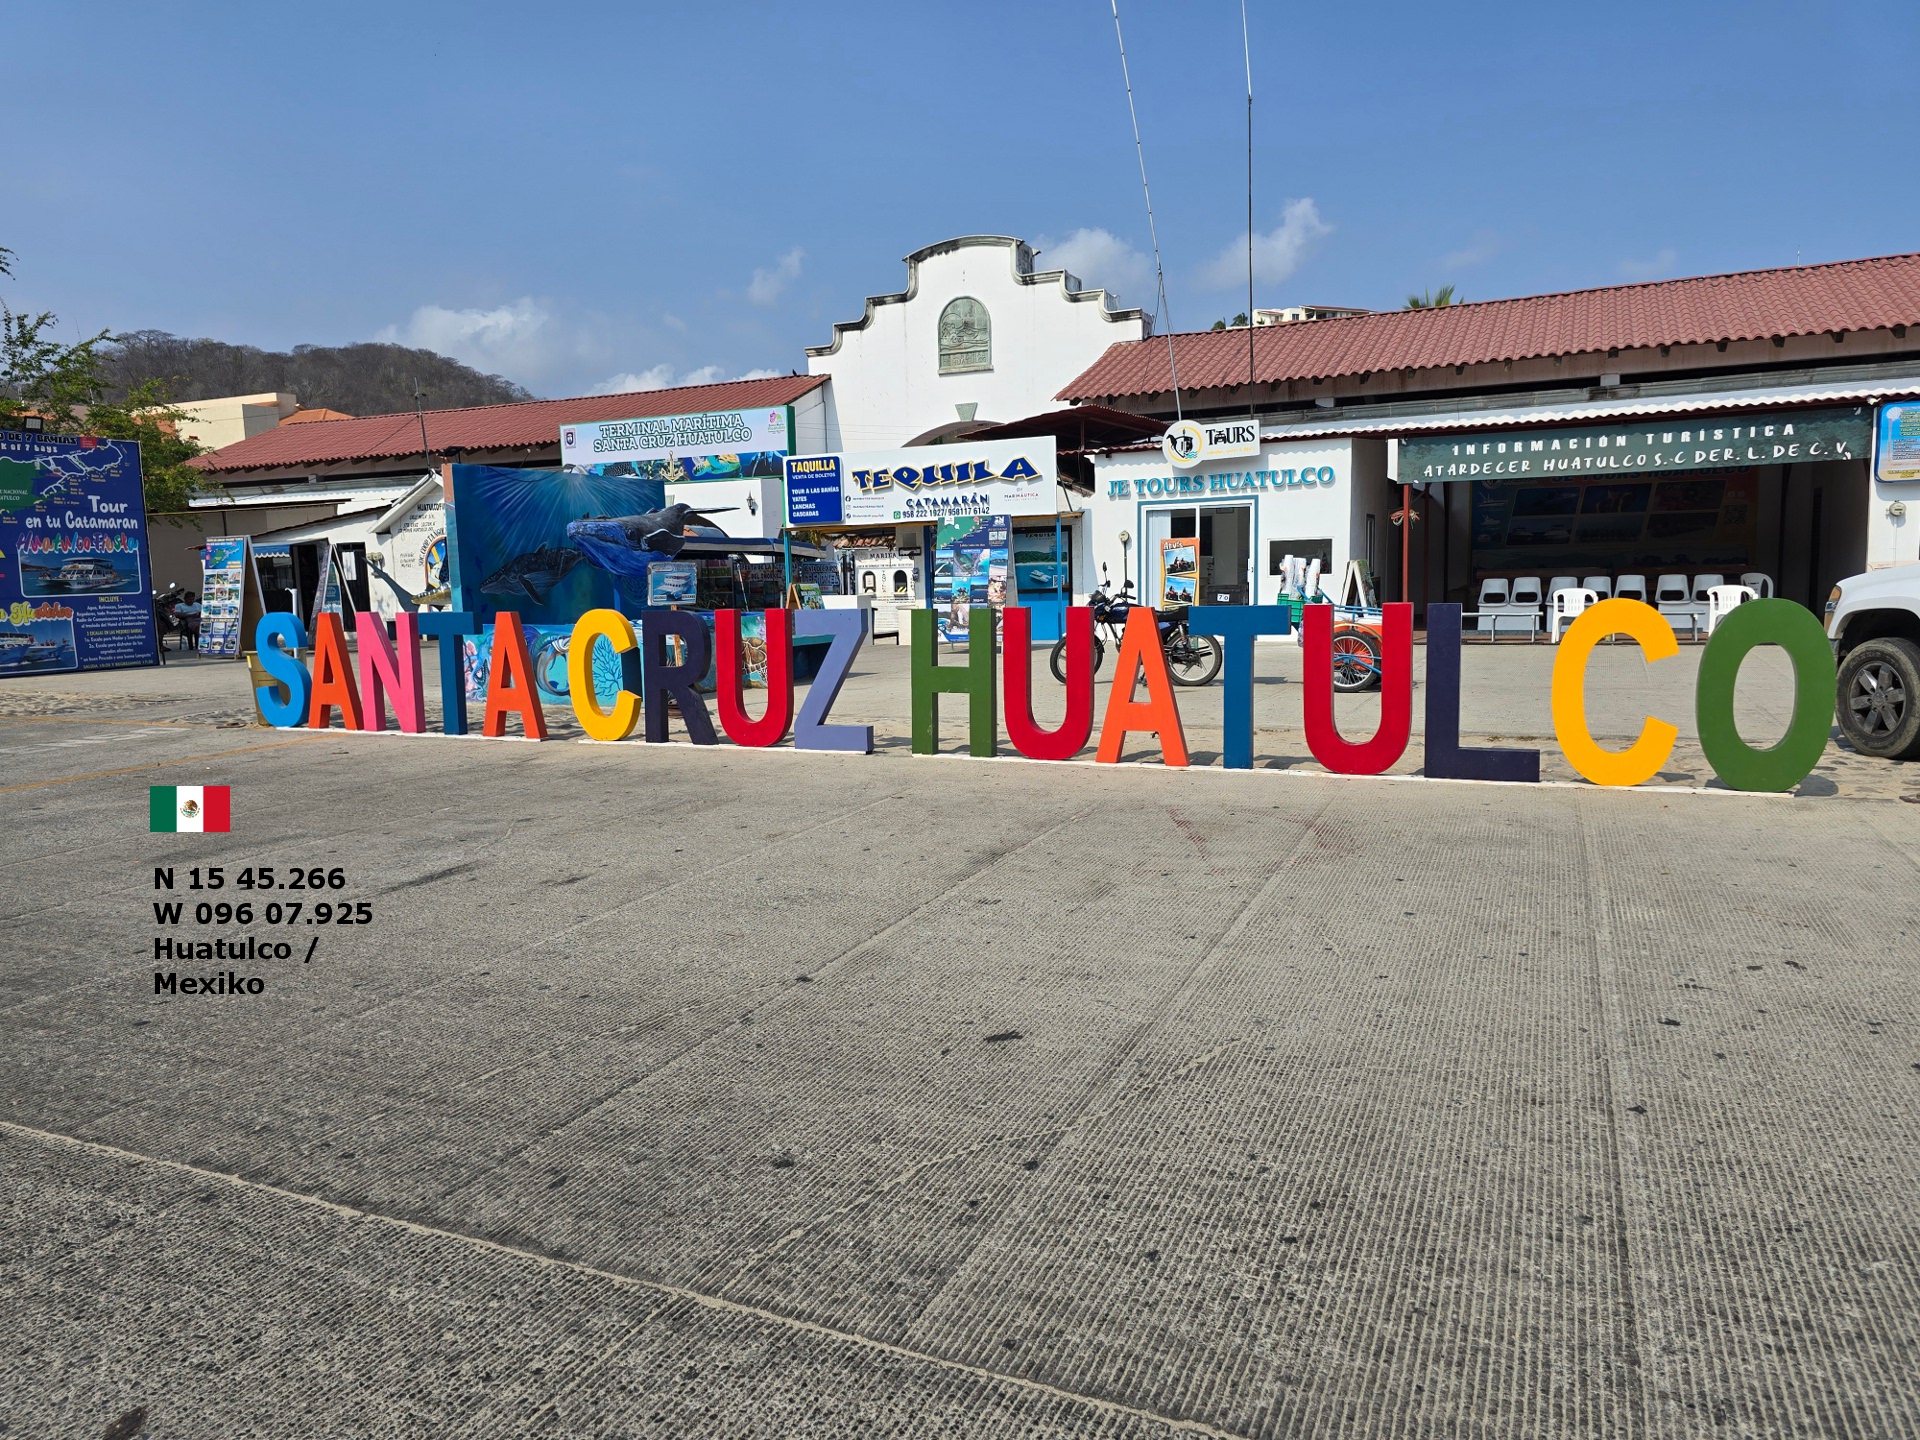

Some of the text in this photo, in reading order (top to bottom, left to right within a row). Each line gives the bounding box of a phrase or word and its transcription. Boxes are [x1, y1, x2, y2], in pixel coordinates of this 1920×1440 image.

[599, 418, 669, 438] TERMINAL
[670, 413, 744, 433] MARÍTIMA
[593, 436, 638, 453] SANTA
[639, 432, 675, 449] CRUZ
[676, 427, 753, 446] HUATULCO
[790, 459, 836, 474] TAQUILLA
[1423, 459, 1532, 478] ATARDECER
[1543, 454, 1646, 472] HUATULCO
[1772, 443, 1800, 459] DE
[851, 455, 1042, 491] TEQUILA
[1107, 465, 1335, 496] JE TOURS HUATULCO
[87, 495, 128, 513] Tour
[906, 492, 989, 508] CATAMARÁN
[25, 516, 41, 529] en
[46, 514, 61, 529] tu
[65, 510, 139, 530] Catamaran
[792, 510, 819, 518] CASCADAS
[902, 510, 915, 518] 958
[916, 510, 928, 518] 222
[973, 507, 990, 515] 6142
[256, 597, 1838, 793] SANTA CRUZ HUATULCO
